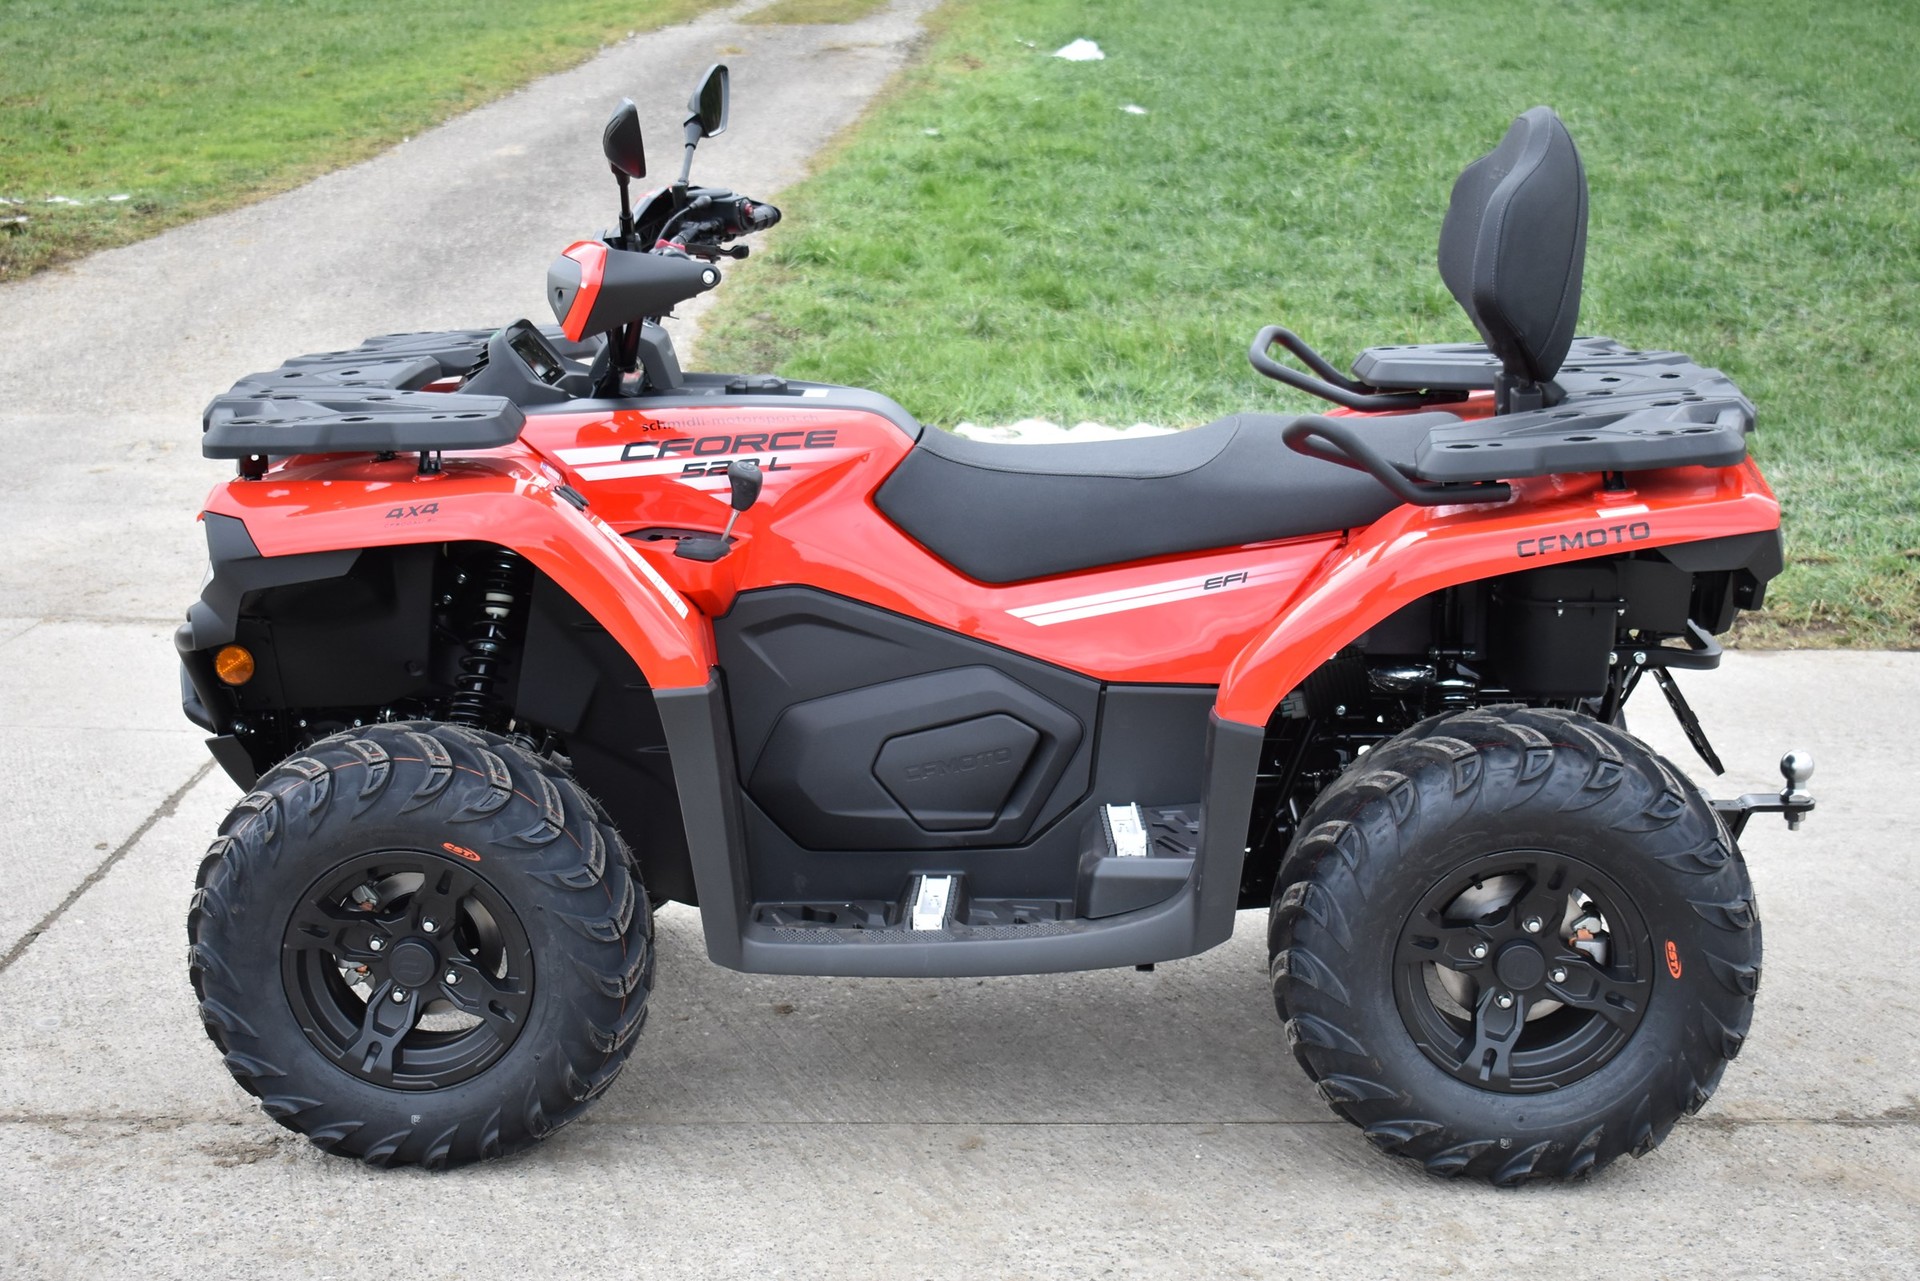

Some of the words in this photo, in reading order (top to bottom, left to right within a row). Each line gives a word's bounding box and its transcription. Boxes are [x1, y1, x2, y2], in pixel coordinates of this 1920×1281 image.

[620, 430, 838, 461] CFORCE
[768, 457, 792, 472] L
[1516, 521, 1650, 558] CFMOTO
[1203, 571, 1248, 590] EFI
[903, 747, 1011, 783] CFMOTO
